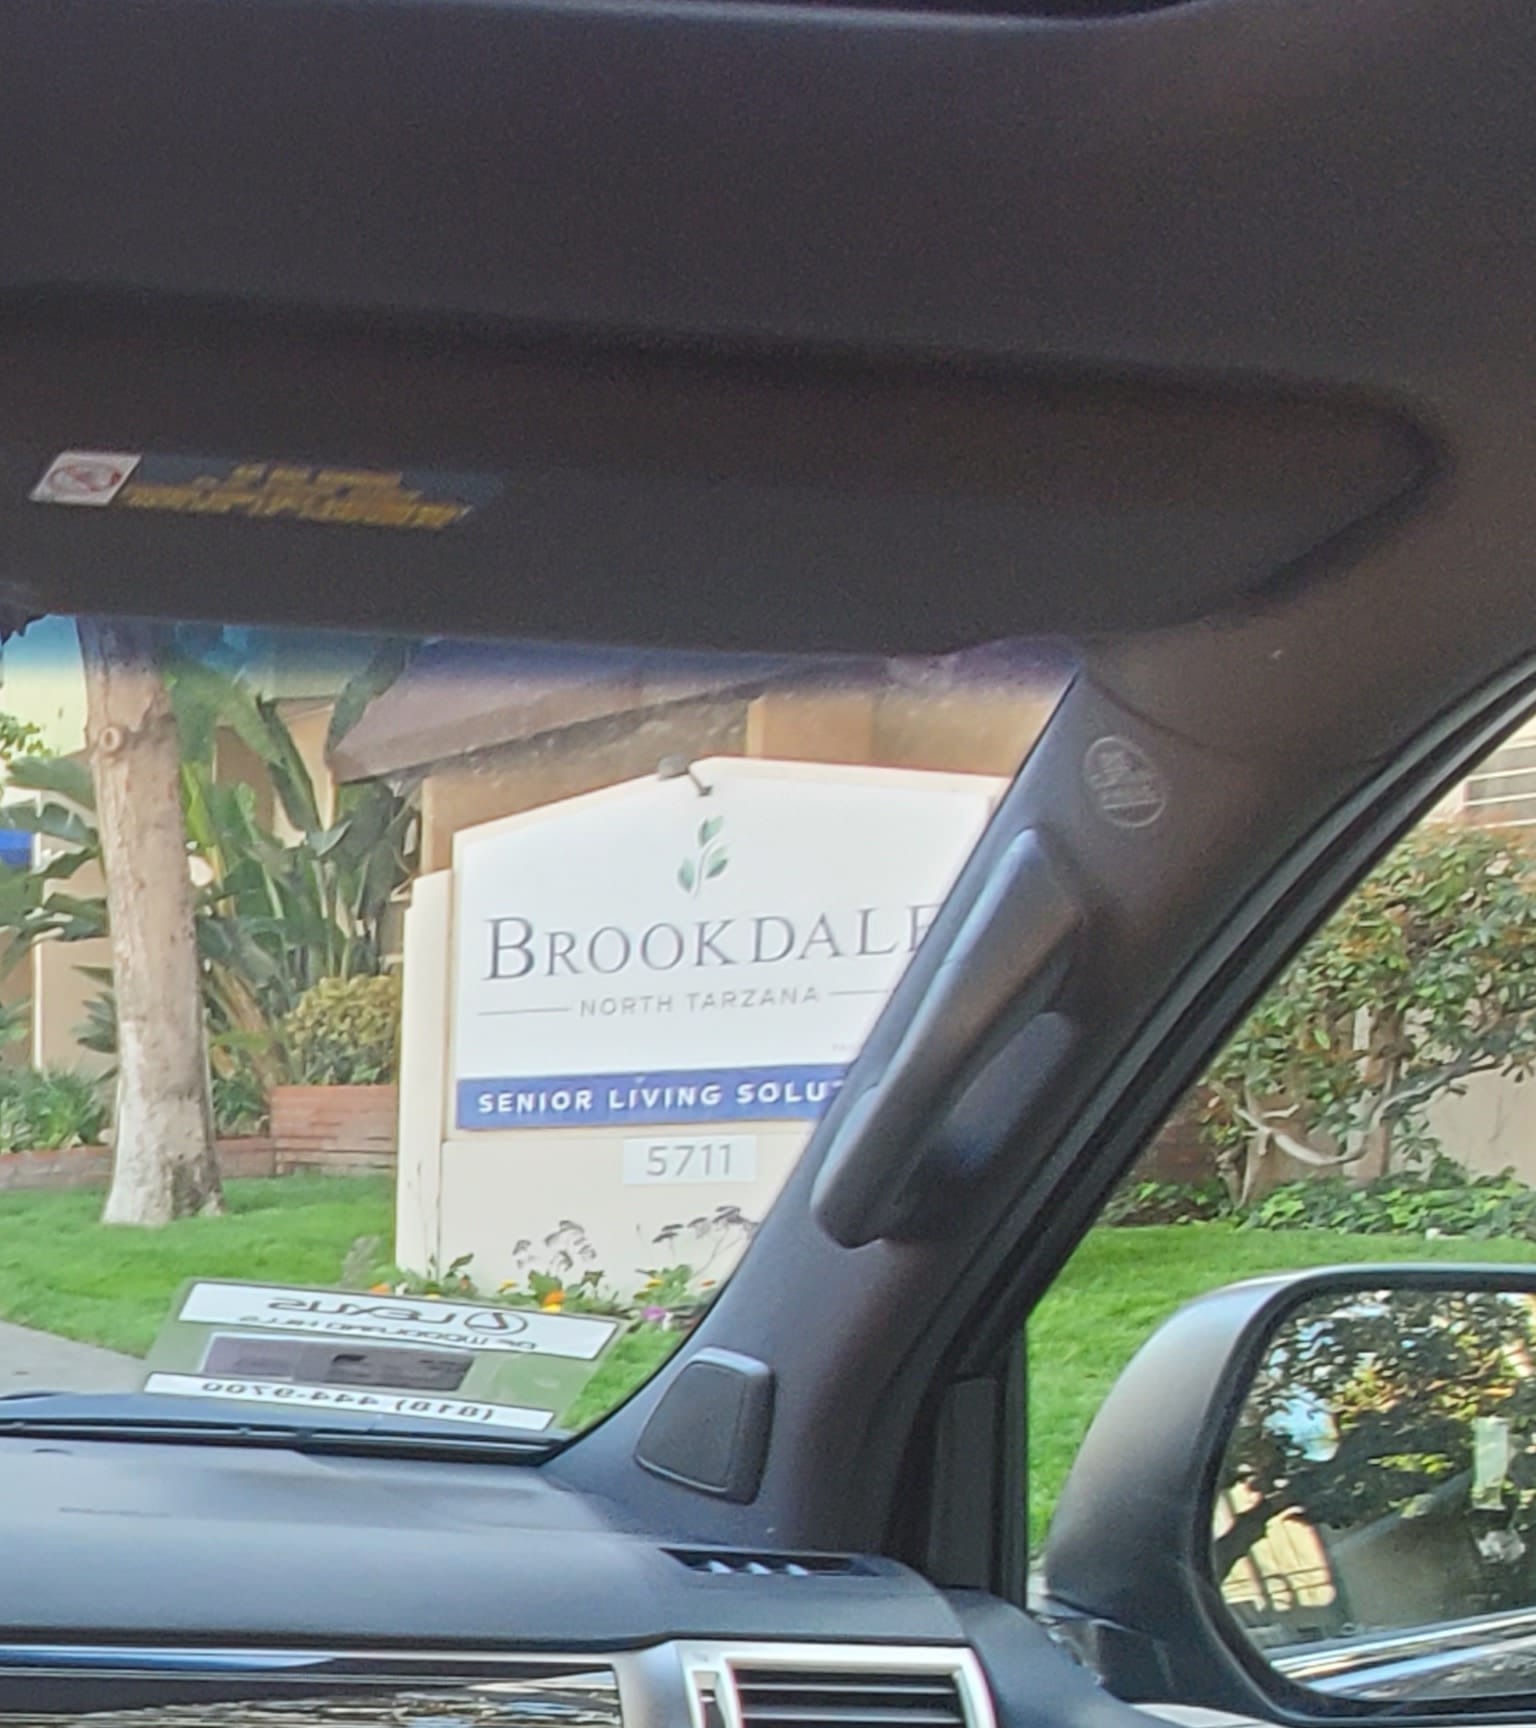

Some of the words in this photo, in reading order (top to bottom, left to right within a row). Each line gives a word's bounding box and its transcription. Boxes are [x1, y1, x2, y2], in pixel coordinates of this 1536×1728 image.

[580, 996, 673, 1018] NORTH
[687, 986, 820, 1012] TARZANA
[478, 1089, 593, 1114] SENIOR
[608, 1083, 723, 1110] LIVING
[645, 1143, 733, 1176] 5711
